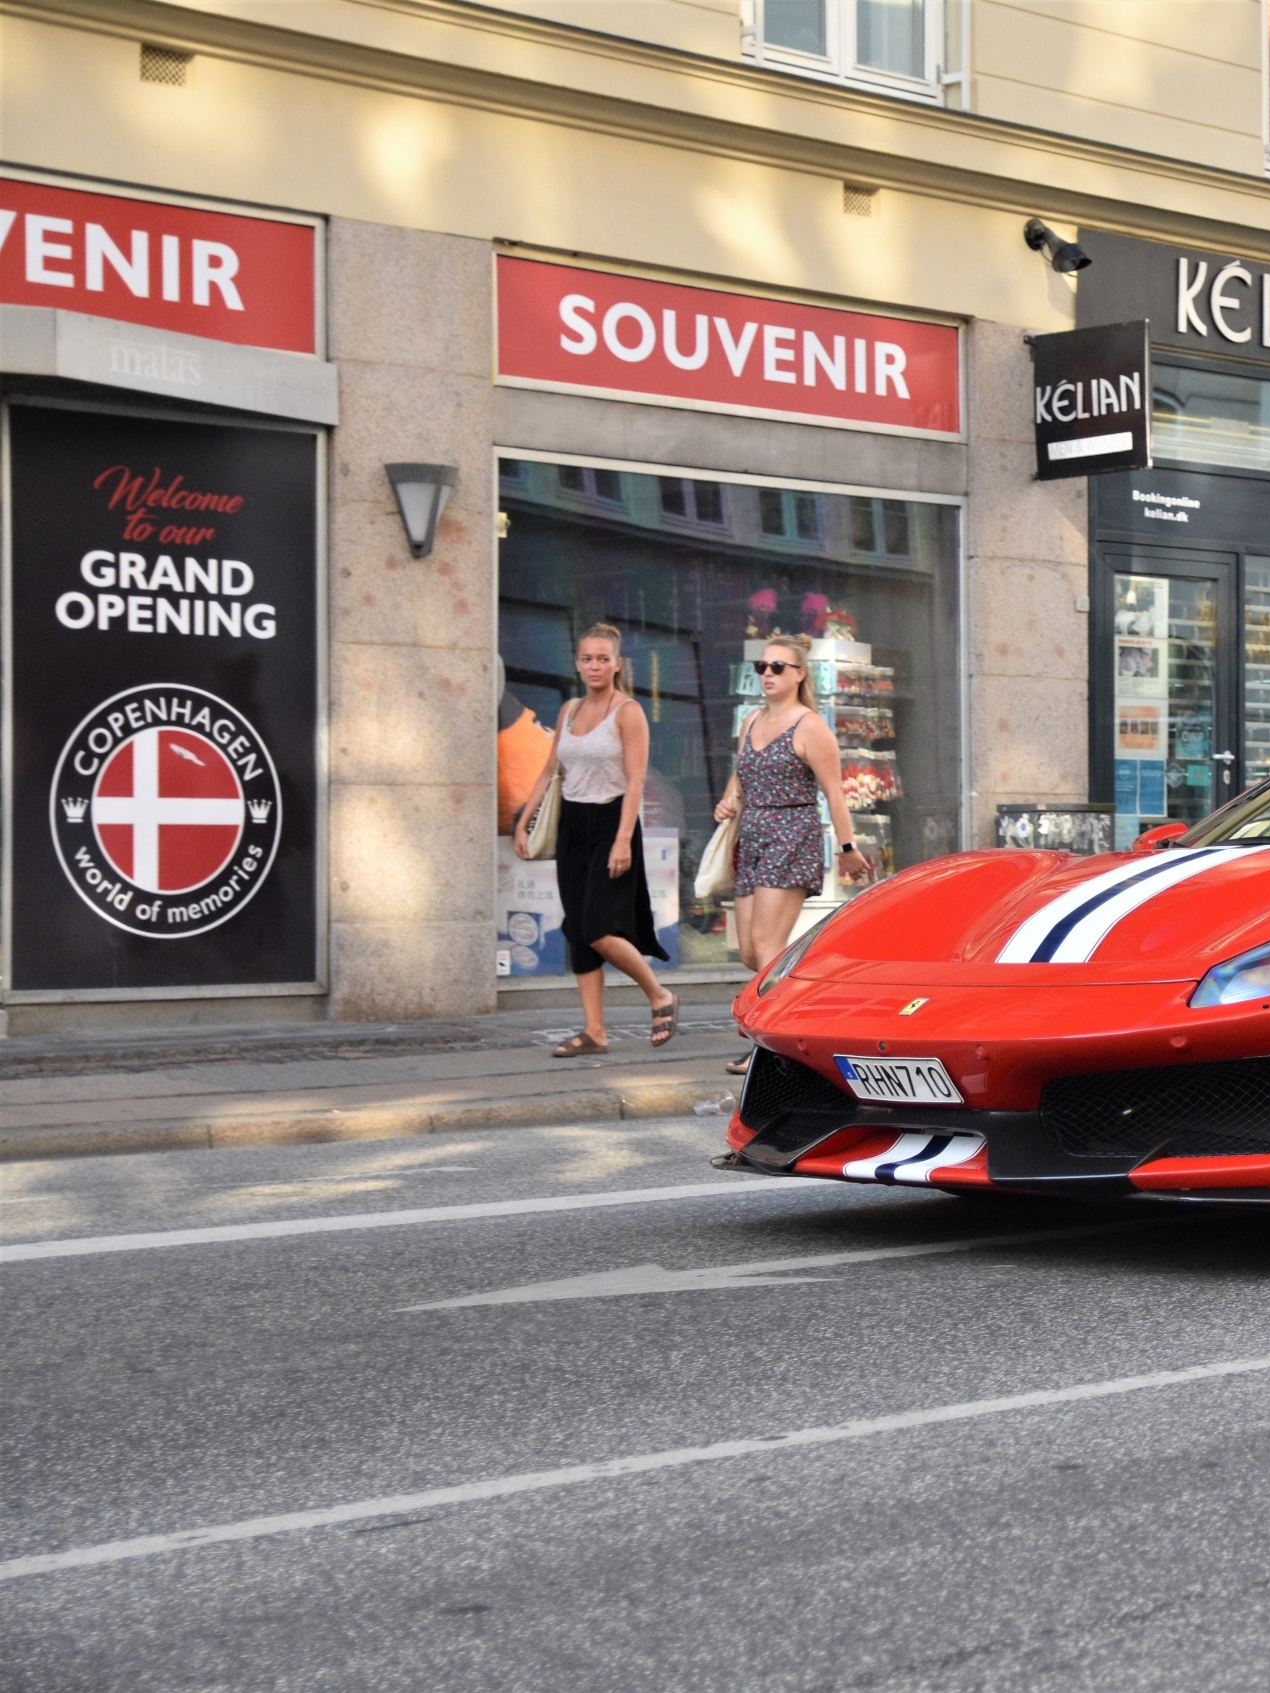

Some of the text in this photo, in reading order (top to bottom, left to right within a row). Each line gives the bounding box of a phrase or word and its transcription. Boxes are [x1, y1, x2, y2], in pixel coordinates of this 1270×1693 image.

[109, 342, 202, 387] matas
[558, 293, 911, 400] SOUVENIR
[1035, 371, 1141, 424] KÉLIAN
[93, 465, 244, 514] Welcome
[122, 507, 216, 546] to our
[1144, 507, 1189, 523] kelian.dk
[80, 550, 254, 596] GRAND
[55, 591, 277, 639] OPENING
[73, 696, 264, 782] COPENHAGEN
[74, 844, 264, 923] world of memories
[852, 1063, 952, 1098] RHN710
